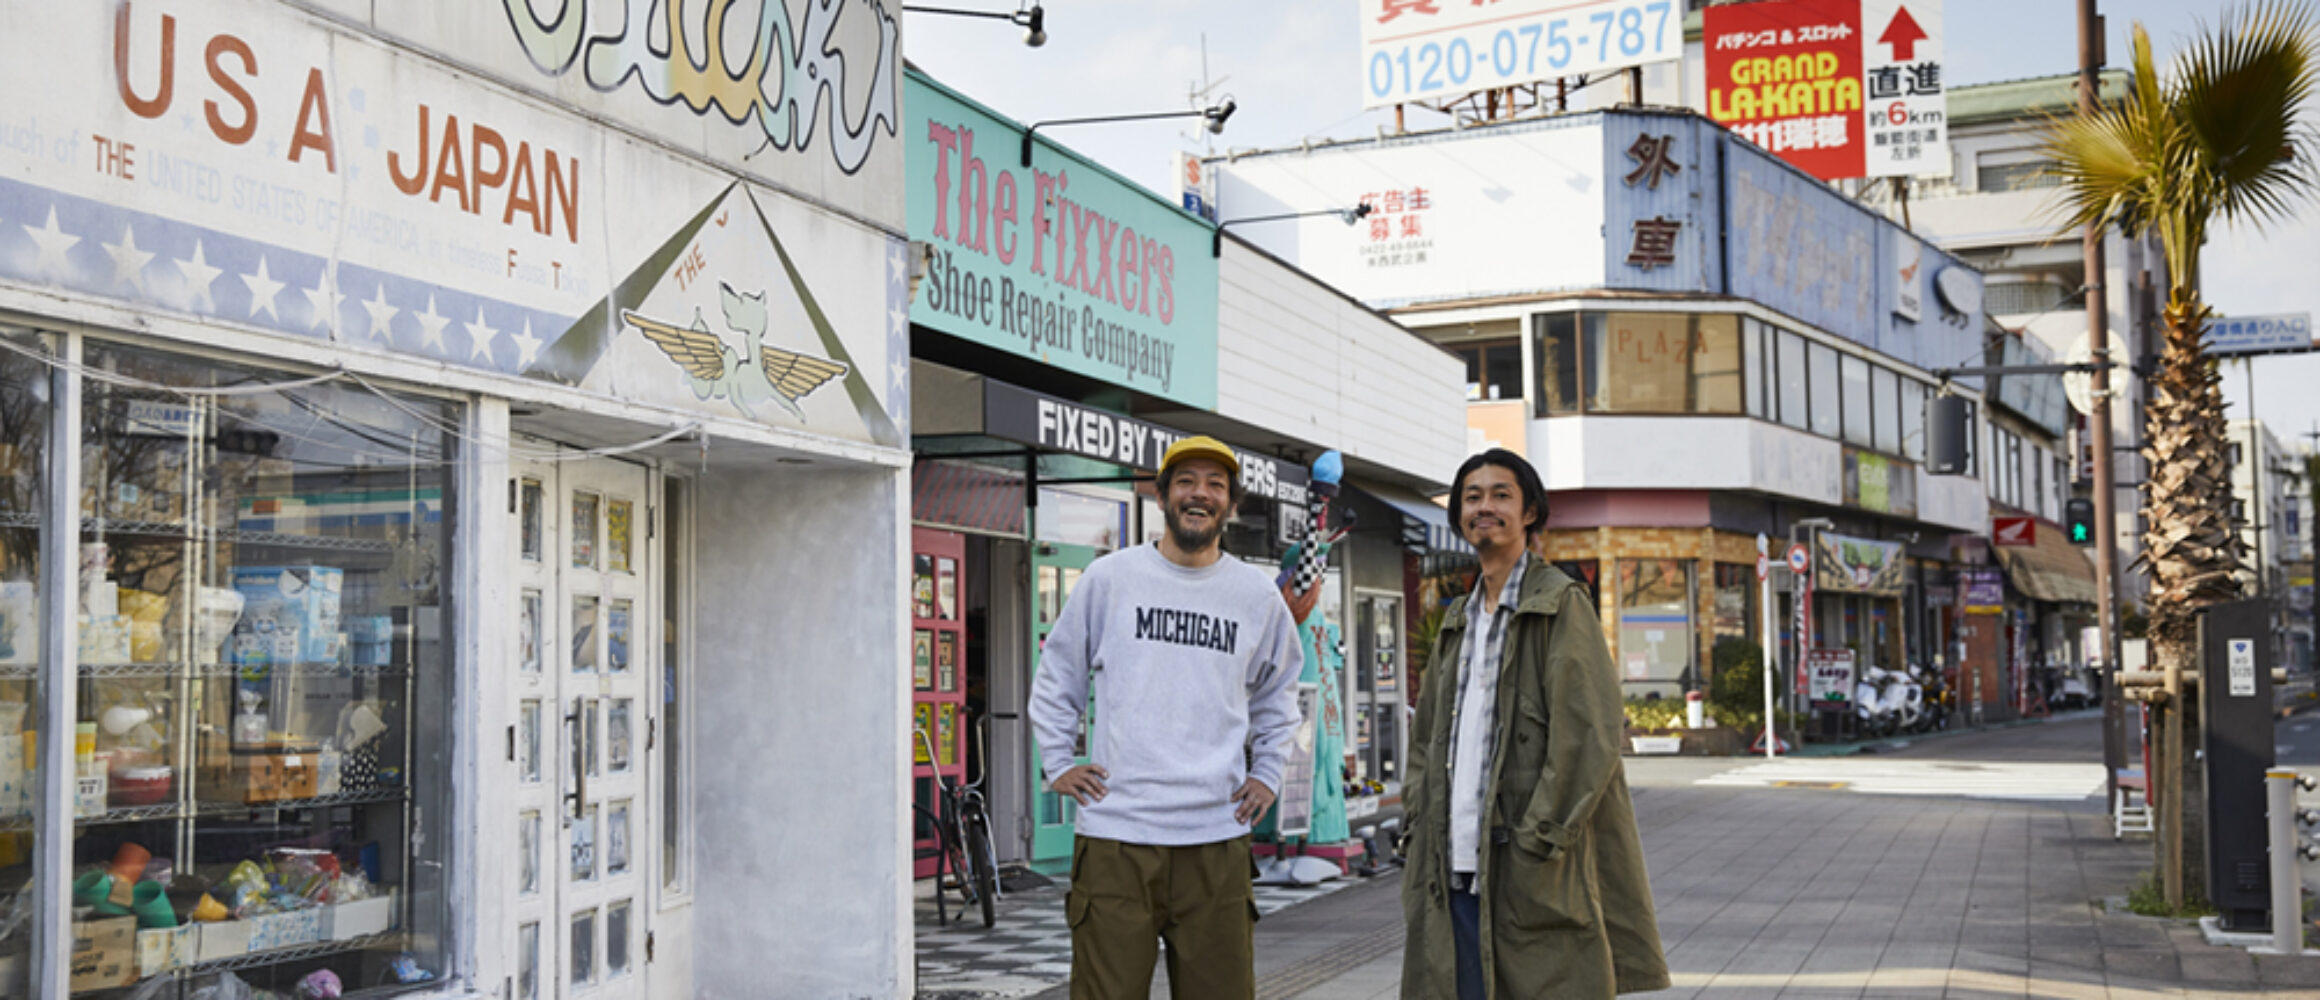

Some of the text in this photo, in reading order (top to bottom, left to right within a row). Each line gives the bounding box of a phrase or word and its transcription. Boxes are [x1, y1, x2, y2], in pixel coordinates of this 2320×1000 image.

[1369, 1, 1671, 98] 0120-075-787
[1716, 29, 1777, 50] パチンコ
[1798, 22, 1853, 42] スロット
[1730, 51, 1839, 85] GRAND
[1868, 62, 1941, 99] 直進
[93, 134, 135, 180] THE
[148, 149, 221, 204] UNITED
[231, 174, 307, 226] STATES
[315, 197, 339, 232] OF
[386, 103, 580, 244] JAPAN
[1624, 132, 1682, 271] 外車
[928, 118, 1176, 326] The Fixxers
[674, 243, 706, 292] THE
[927, 247, 1176, 394] Shoe Repair Company
[1617, 328, 1709, 364] PLAZA
[1037, 399, 1115, 460] FIXED
[1118, 422, 1148, 466] BY
[1152, 430, 1181, 471] TH
[1136, 606, 1238, 655] MICHIGAN
